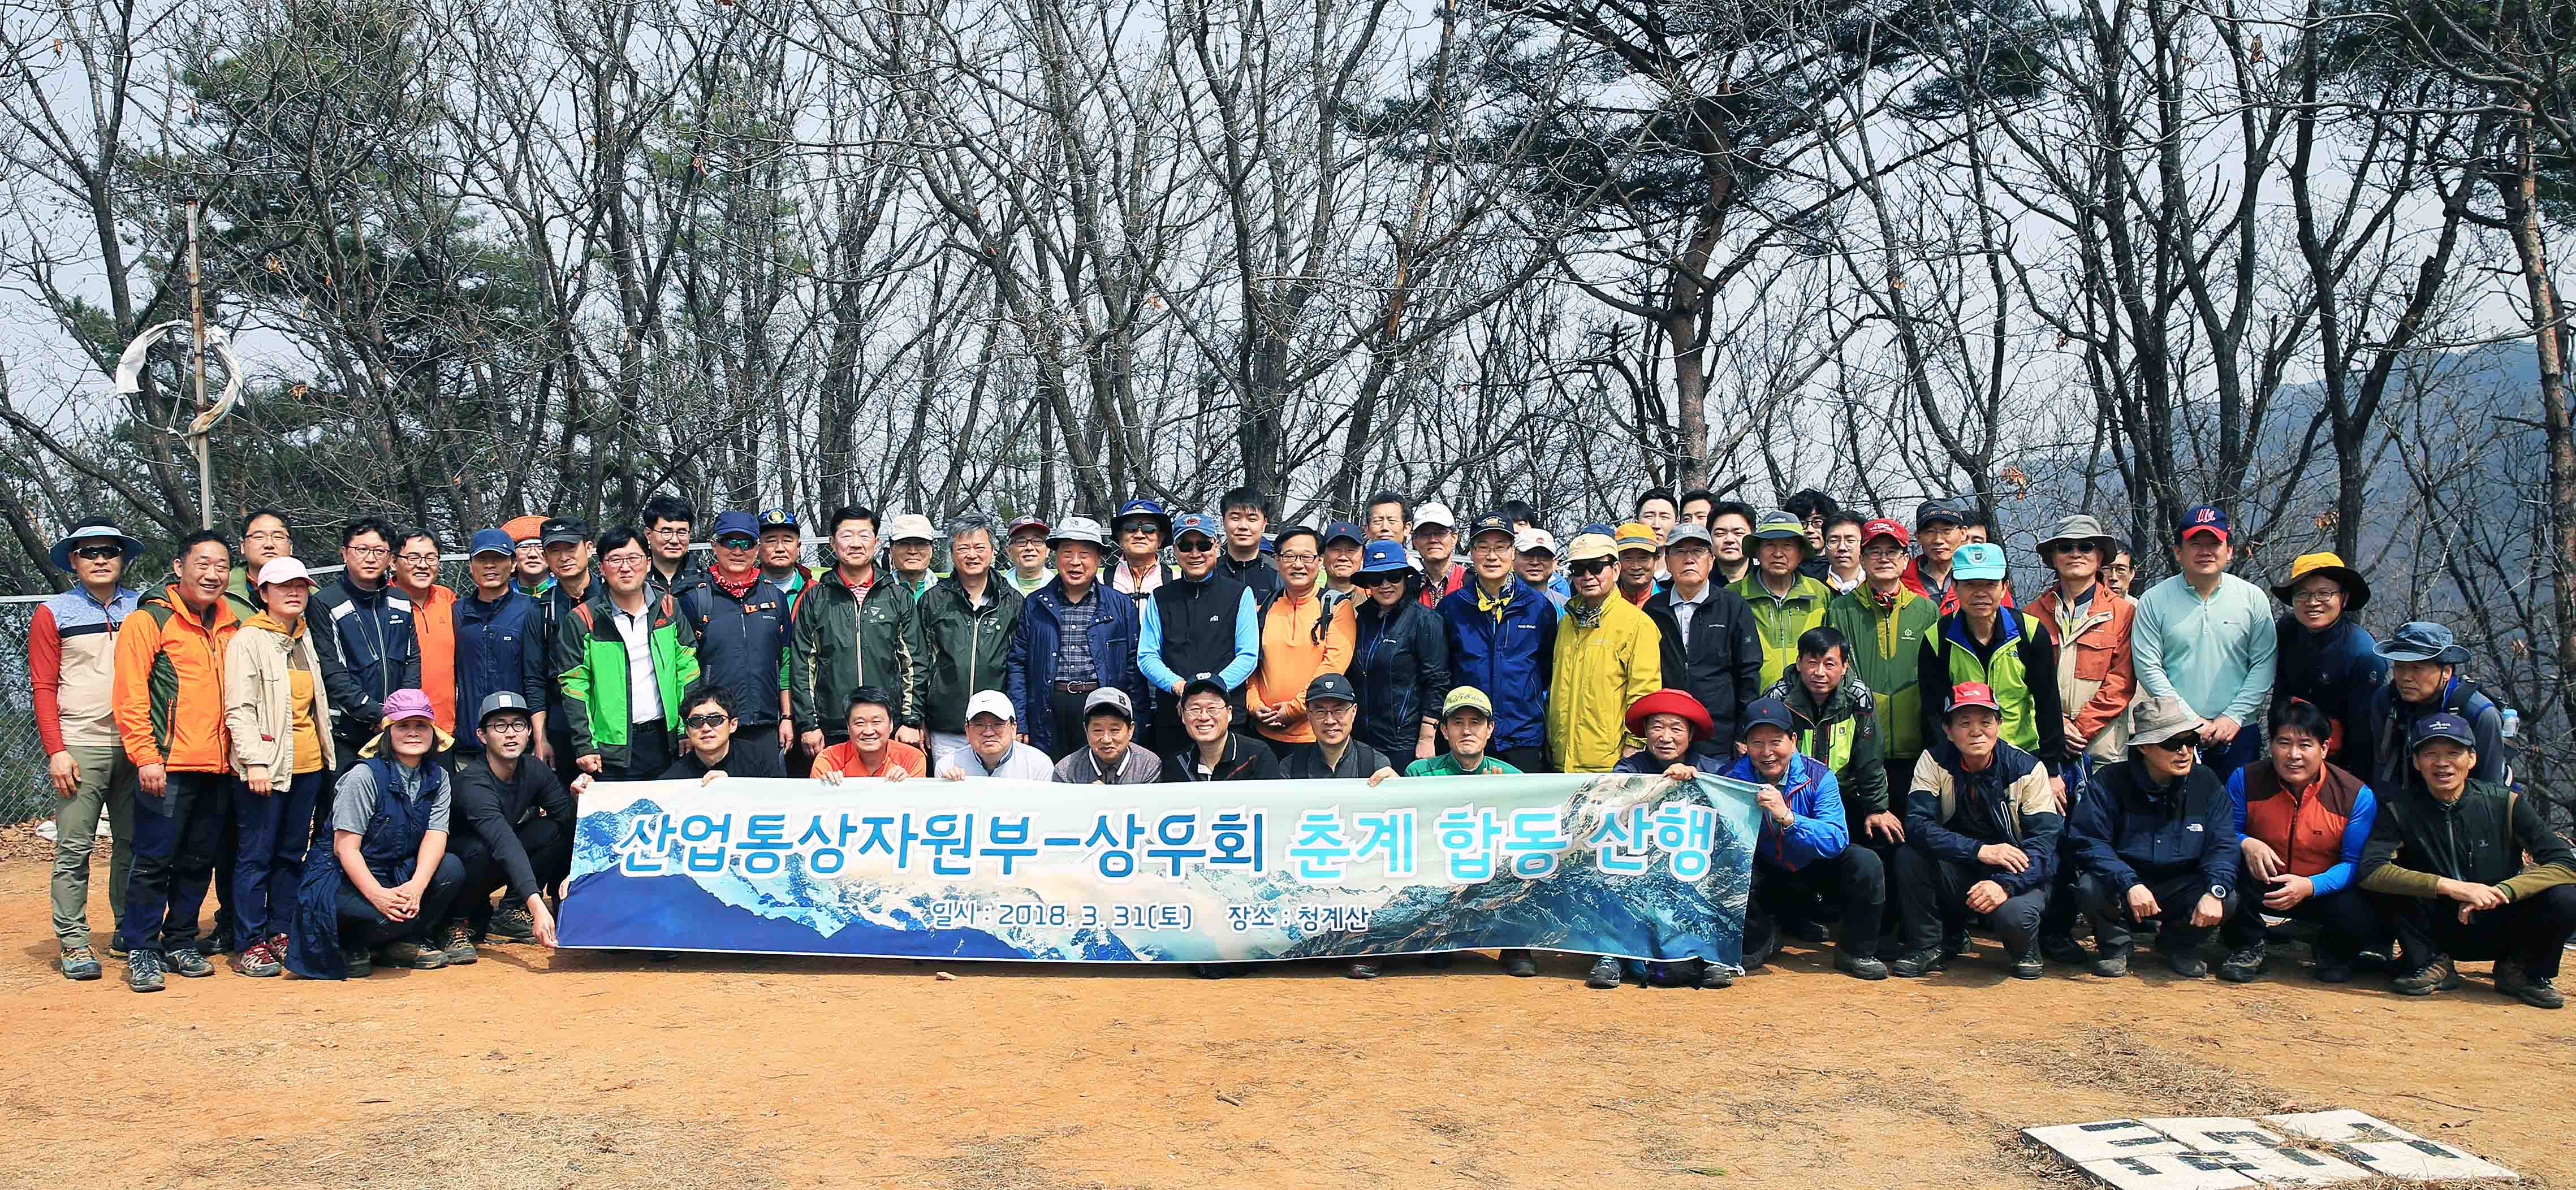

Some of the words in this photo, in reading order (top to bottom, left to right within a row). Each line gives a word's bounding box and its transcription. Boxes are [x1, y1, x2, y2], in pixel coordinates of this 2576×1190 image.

[620, 813, 1263, 878] 산업통상자원부-상우회
[1290, 812, 1412, 878] 춘계
[1438, 812, 1567, 879] 합동
[1589, 806, 1712, 876] 산행
[933, 902, 975, 926] 일시
[998, 904, 1072, 928] 2018.
[1081, 906, 1104, 928] 3.
[1114, 904, 1192, 929] 31(토)
[1228, 905, 1274, 931] 장소
[1298, 905, 1370, 931] 청계산
